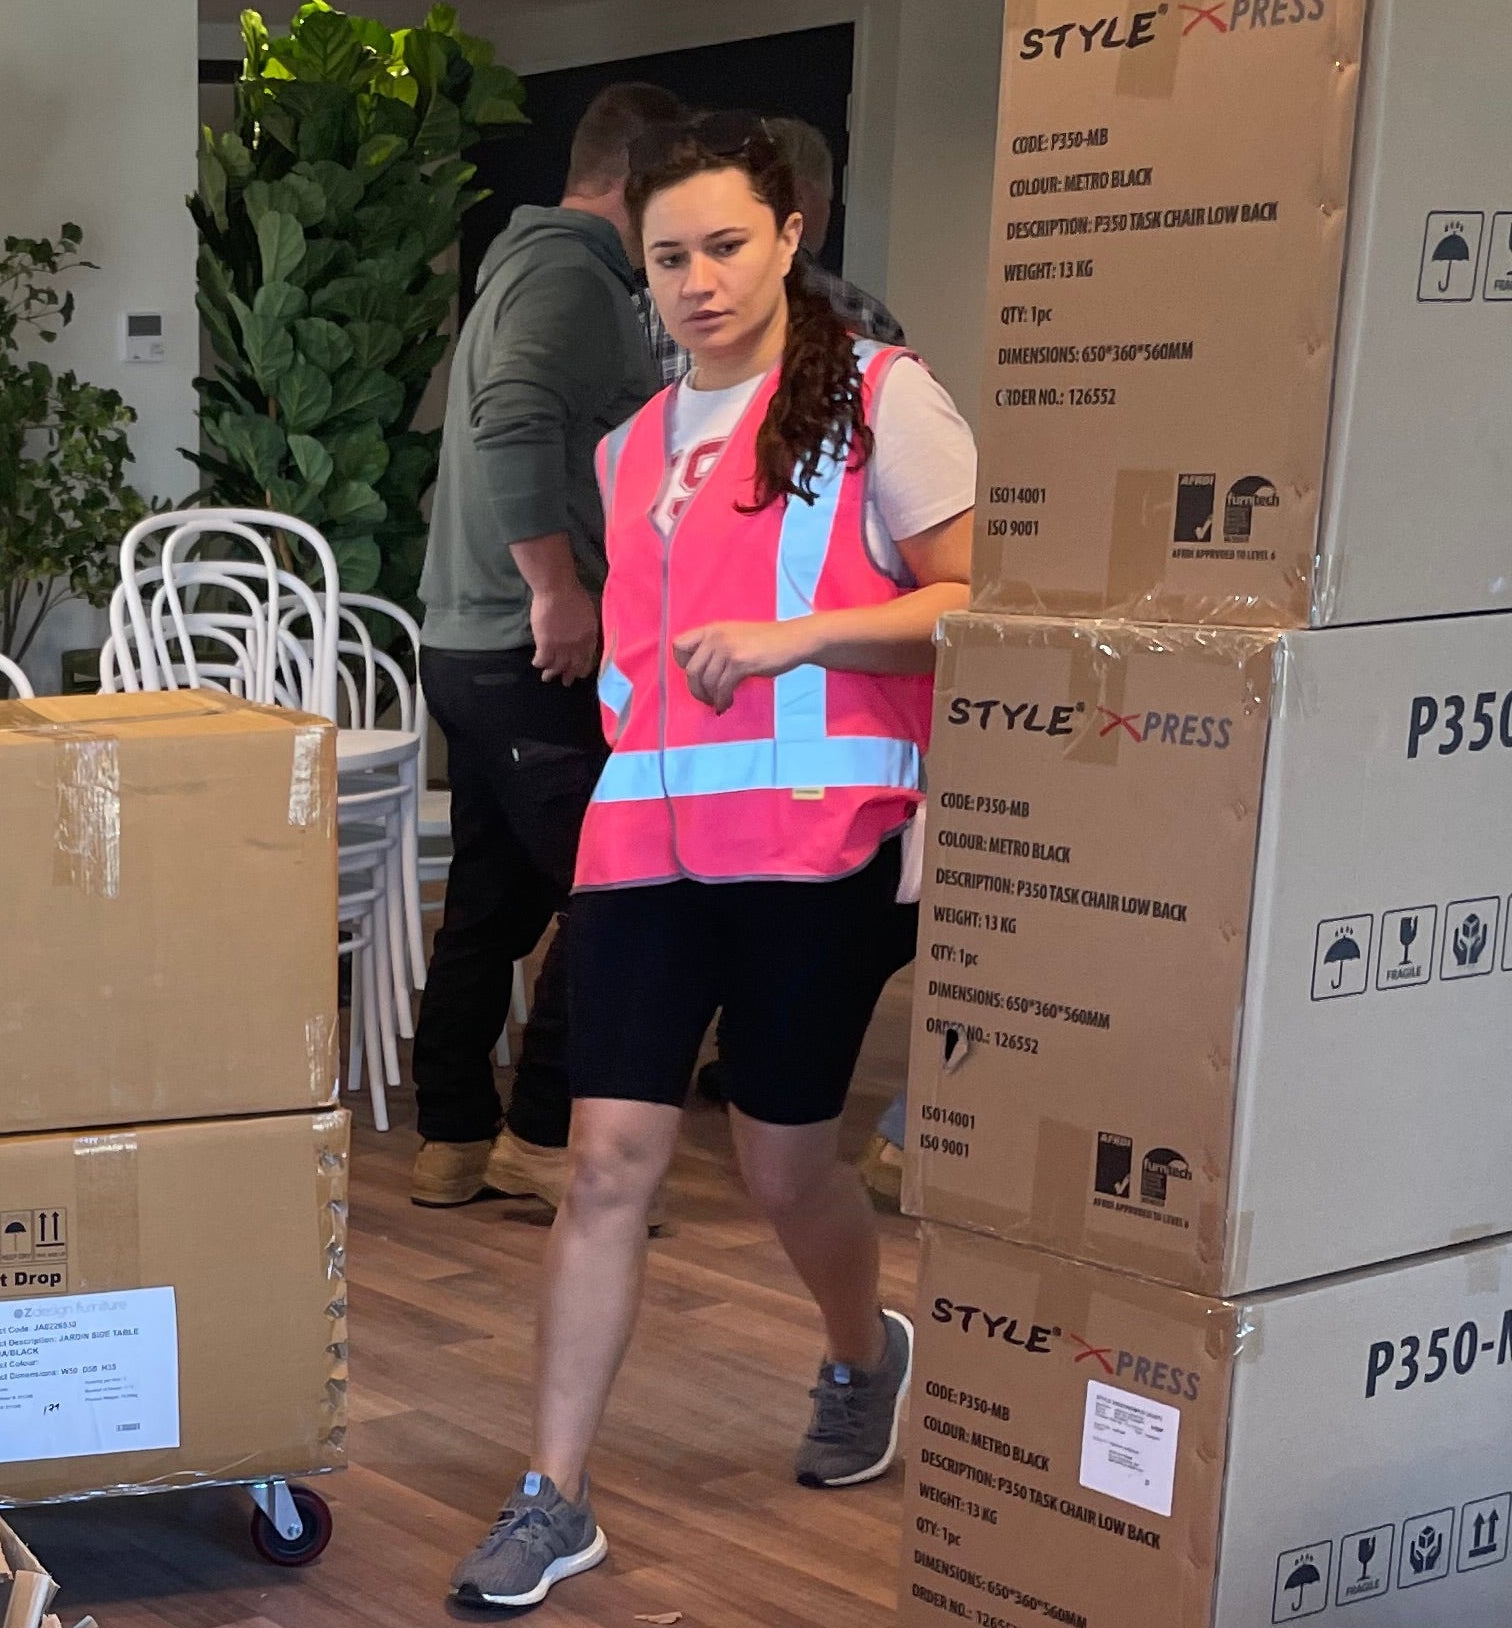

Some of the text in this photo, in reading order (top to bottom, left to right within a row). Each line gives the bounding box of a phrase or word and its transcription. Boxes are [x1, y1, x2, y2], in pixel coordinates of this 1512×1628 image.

[1019, 11, 1157, 60] STYLE
[1012, 127, 1109, 155] CODE: P350-MB
[1009, 167, 1153, 198] COLOUR: METRO BLACK
[1006, 200, 1278, 240] DESCRIPTION: P350 TASK CHAIR LOW BACK
[1004, 259, 1093, 282] WEIGHT: 13 KG
[1001, 306, 1053, 327] QTY: 1pc
[998, 346, 1080, 365] DIMENSIONS:
[1039, 388, 1065, 406] NO.:
[1069, 388, 1116, 405] 126552
[990, 487, 1046, 504] ISO14001
[987, 519, 1040, 536] ISO 9001
[948, 698, 1074, 737] STYLE
[941, 792, 1030, 818] CODE: P350-MB
[938, 830, 1071, 864] COLOUR: METRO BLACK
[936, 868, 1188, 922] DESCRIPTION: P350 TASK CHAIR LOW BACK
[934, 905, 1017, 934] WEIGHT: 13 KG
[931, 943, 979, 968] QTY: 1pc
[1386, 965, 1422, 981] FRAGILE
[928, 980, 1005, 1009] DIMENSIONS:
[967, 1025, 990, 1044] NO.:
[994, 1031, 1039, 1055] 126552
[922, 1104, 976, 1130] ISO14001
[920, 1134, 970, 1159] ISO 9001
[14, 1272, 61, 1287] Drop
[91, 1330, 110, 1339] SIDE
[113, 1328, 139, 1337] TABLE
[931, 1298, 1052, 1354] STYLE
[926, 1380, 1011, 1422] CODE: P350-MB
[923, 1415, 1050, 1472] COLOUR: METRO BLACK
[919, 1481, 998, 1525] WEIGHT: 13 KG
[921, 1448, 1161, 1550] DESCRIPTION: P350 TASK CHAIR LOW BACK
[916, 1516, 961, 1547] QTY: 1pc
[914, 1549, 987, 1591] DIMENSIONS:
[912, 1583, 947, 1611] ORDER
